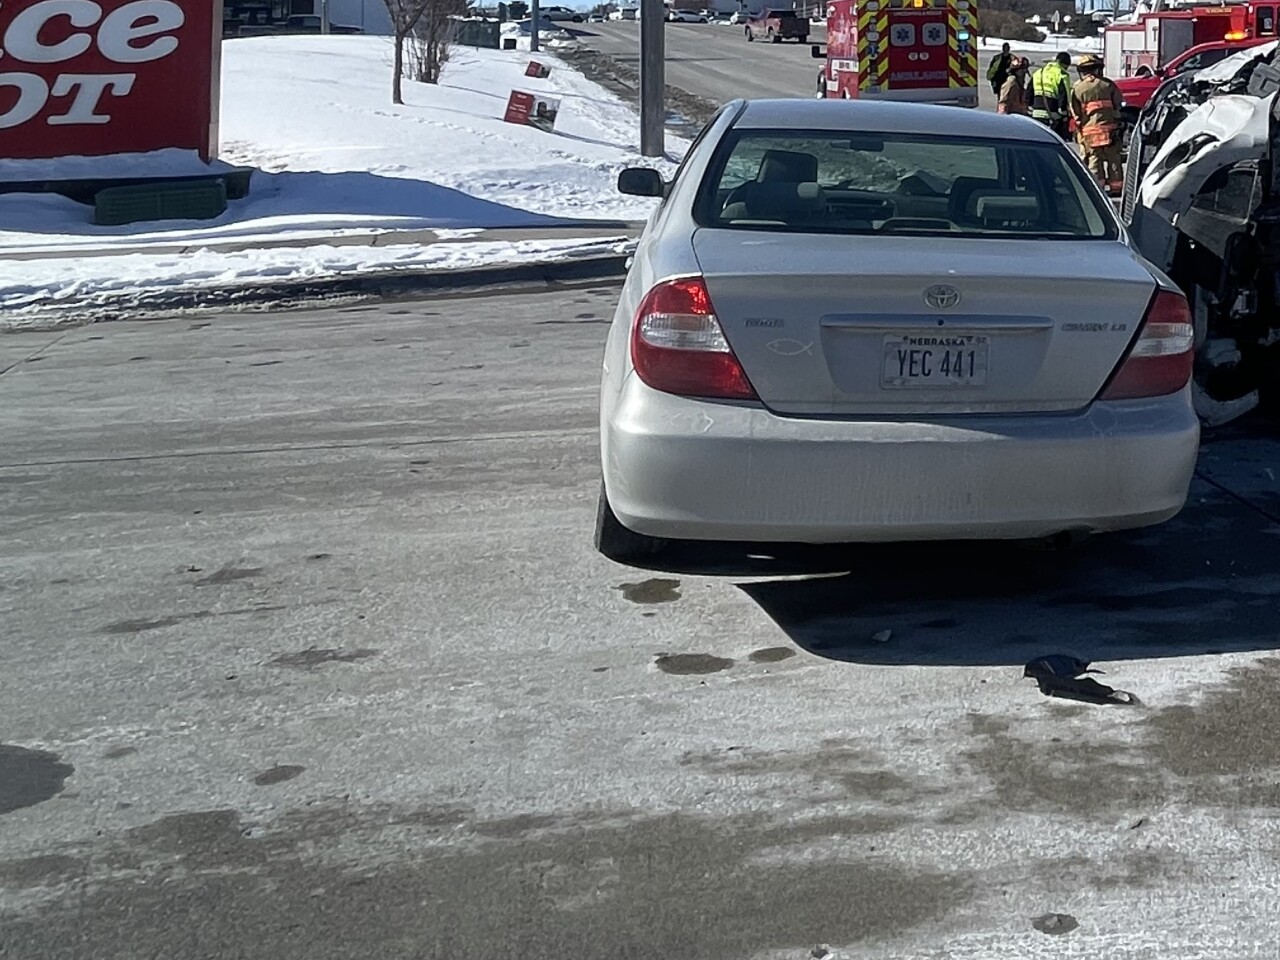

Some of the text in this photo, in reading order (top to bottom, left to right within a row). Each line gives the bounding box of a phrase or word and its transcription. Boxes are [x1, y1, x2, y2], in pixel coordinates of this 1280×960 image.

[909, 337, 966, 347] NEBRASKA
[897, 349, 975, 377] YEC 441
